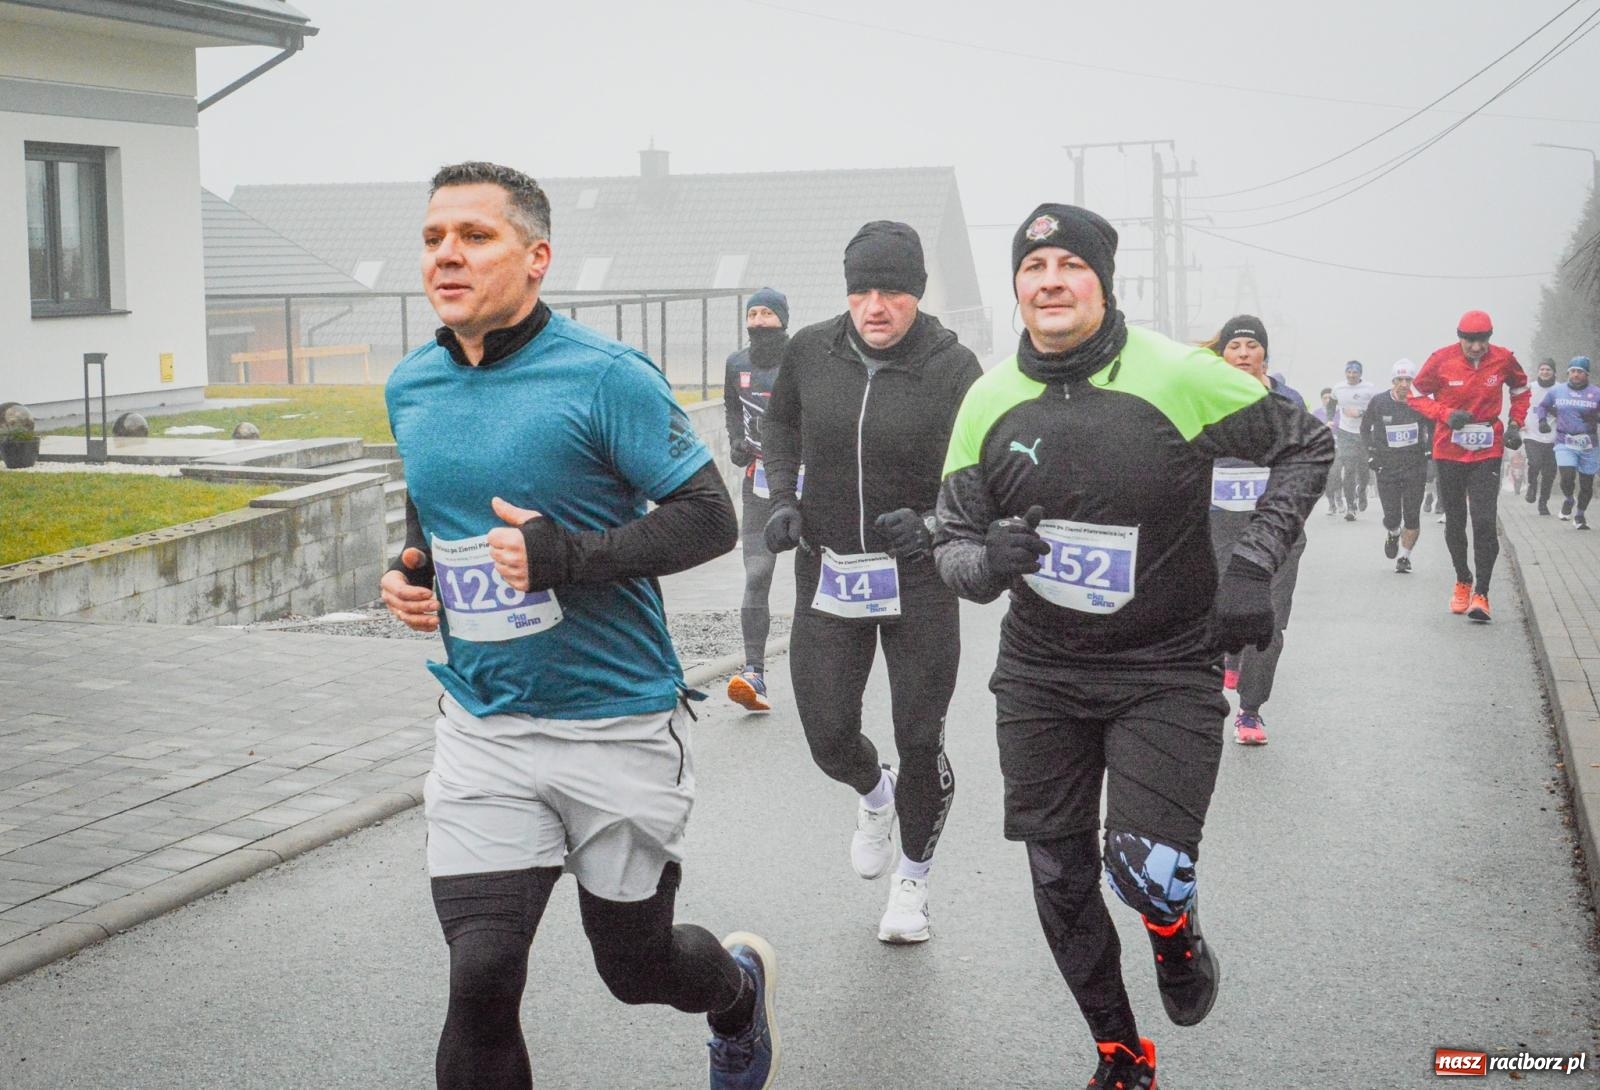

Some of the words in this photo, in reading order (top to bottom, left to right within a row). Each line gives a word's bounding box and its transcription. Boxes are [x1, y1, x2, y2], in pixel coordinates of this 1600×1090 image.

[1395, 431, 1410, 441] 80
[1230, 481, 1258, 500] 11
[1039, 541, 1111, 588] 152
[446, 568, 526, 611] 128
[835, 573, 873, 600] 14
